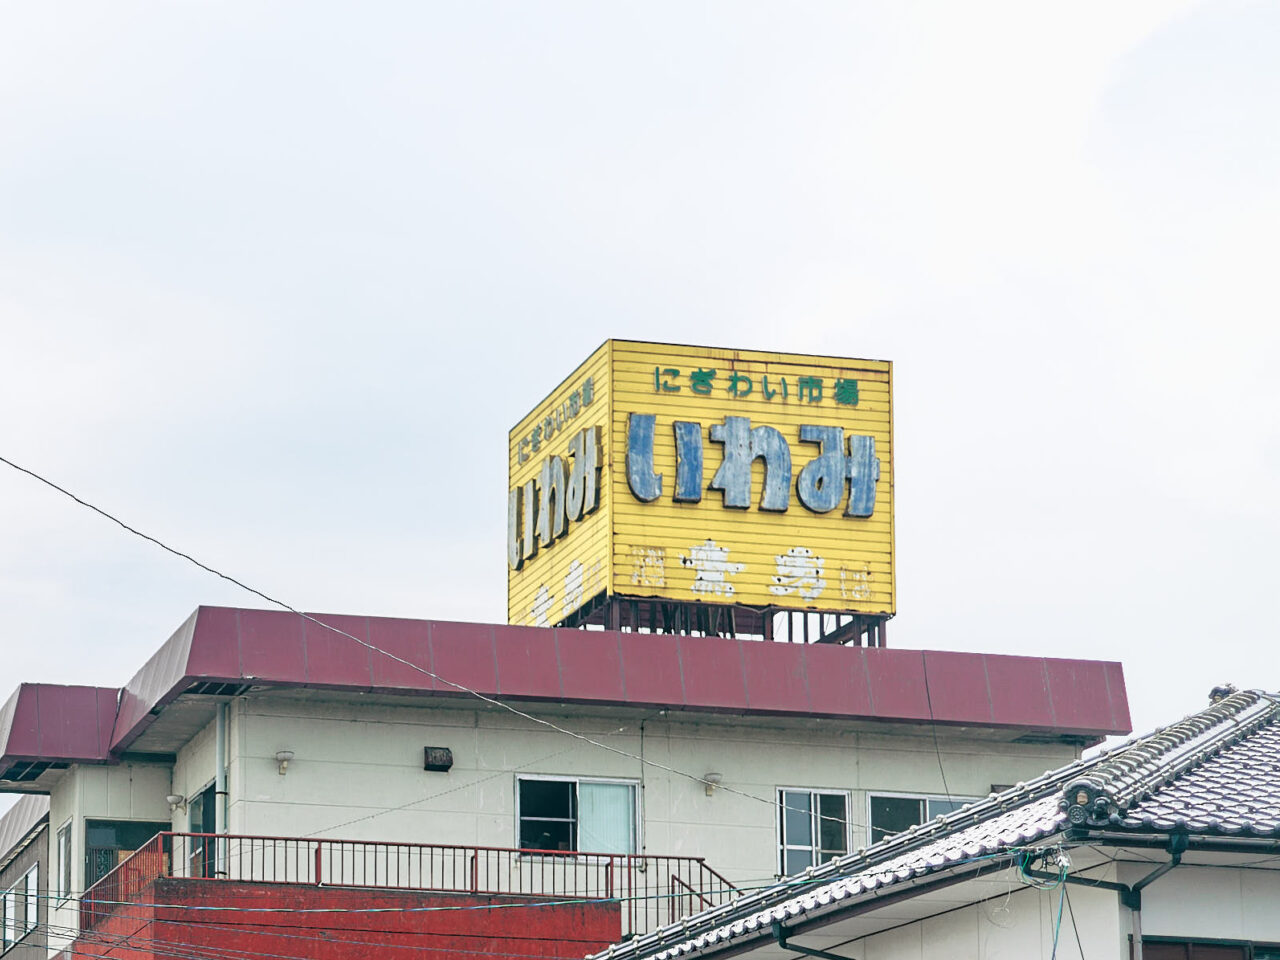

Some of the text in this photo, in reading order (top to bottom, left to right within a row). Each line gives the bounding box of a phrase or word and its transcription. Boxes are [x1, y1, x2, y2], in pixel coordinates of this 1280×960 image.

[653, 365, 860, 406] にぎわい市場
[508, 425, 602, 571] いわみ
[625, 412, 880, 519] いわみ
